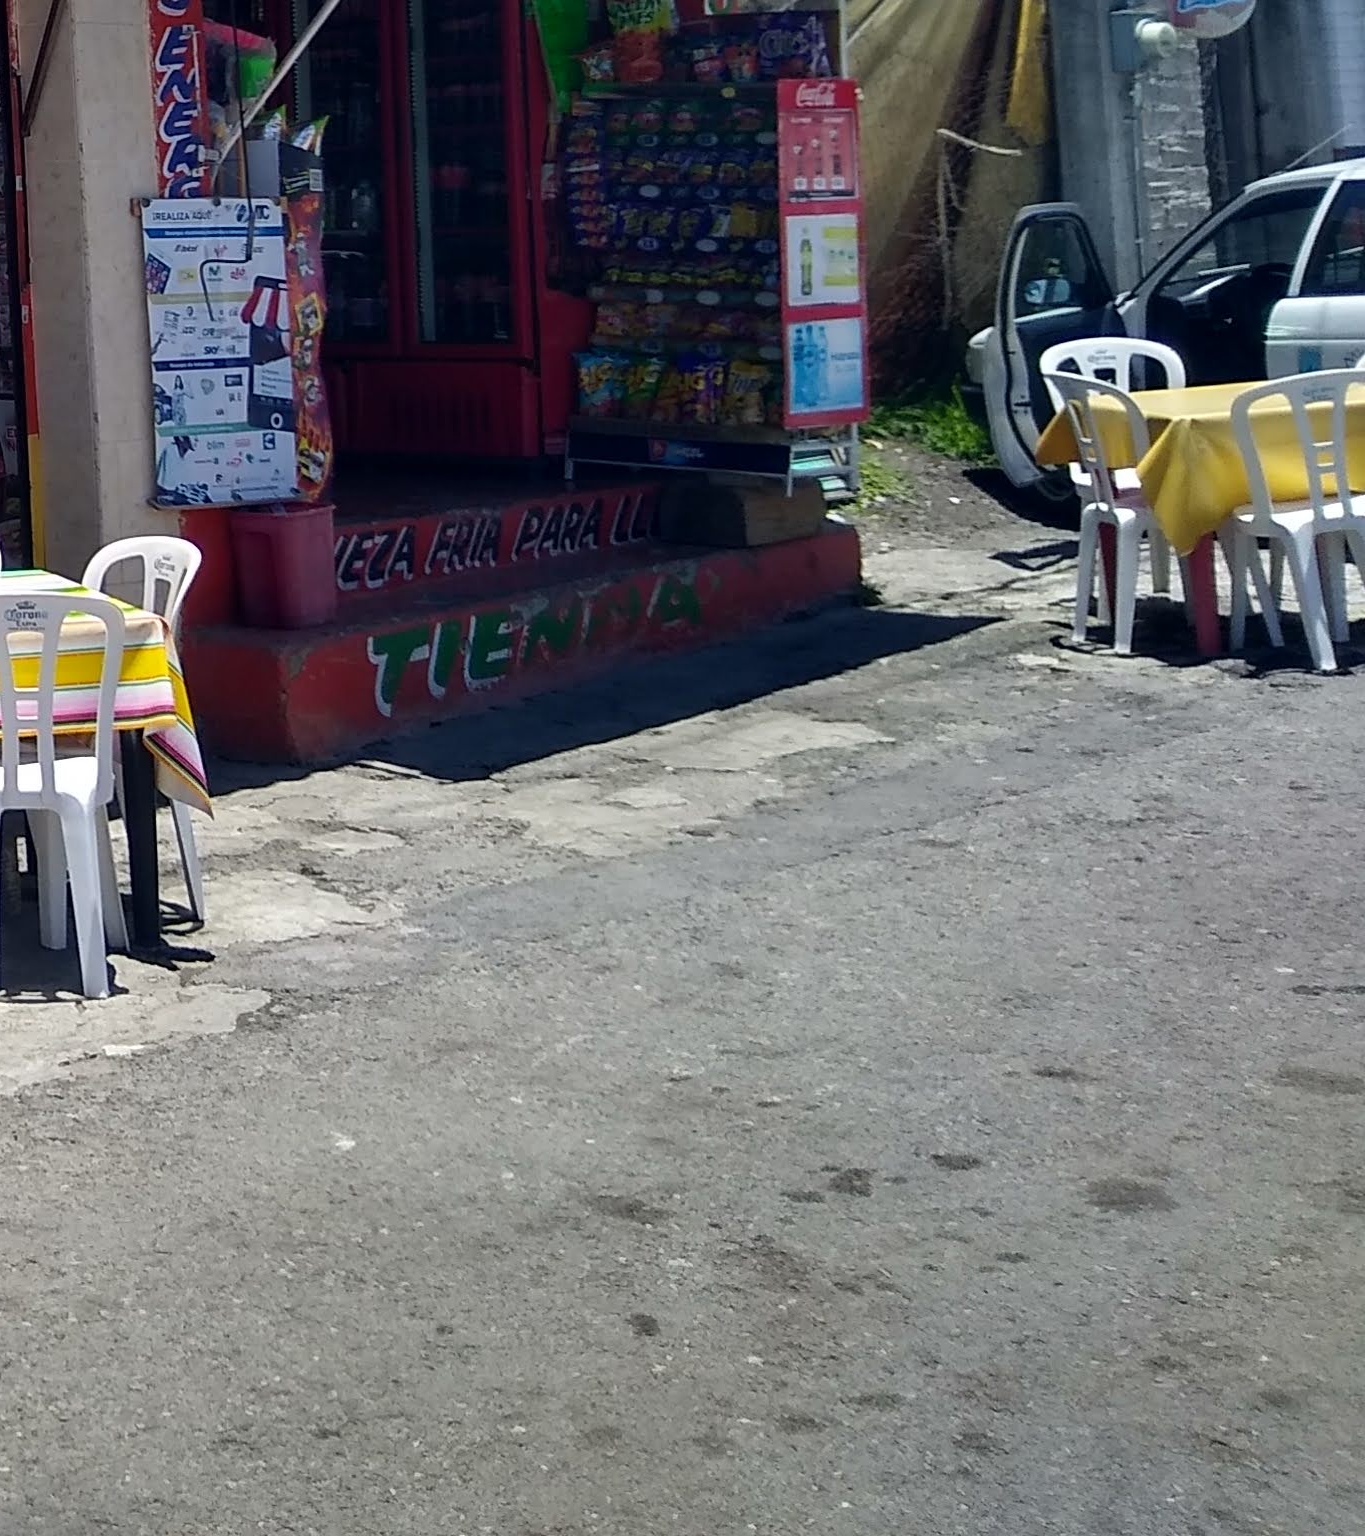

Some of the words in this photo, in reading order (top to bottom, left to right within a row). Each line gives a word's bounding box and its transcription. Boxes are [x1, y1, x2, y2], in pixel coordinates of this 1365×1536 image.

[423, 516, 500, 576] FRIA
[510, 497, 602, 563] PARA
[5, 608, 49, 622] Corona
